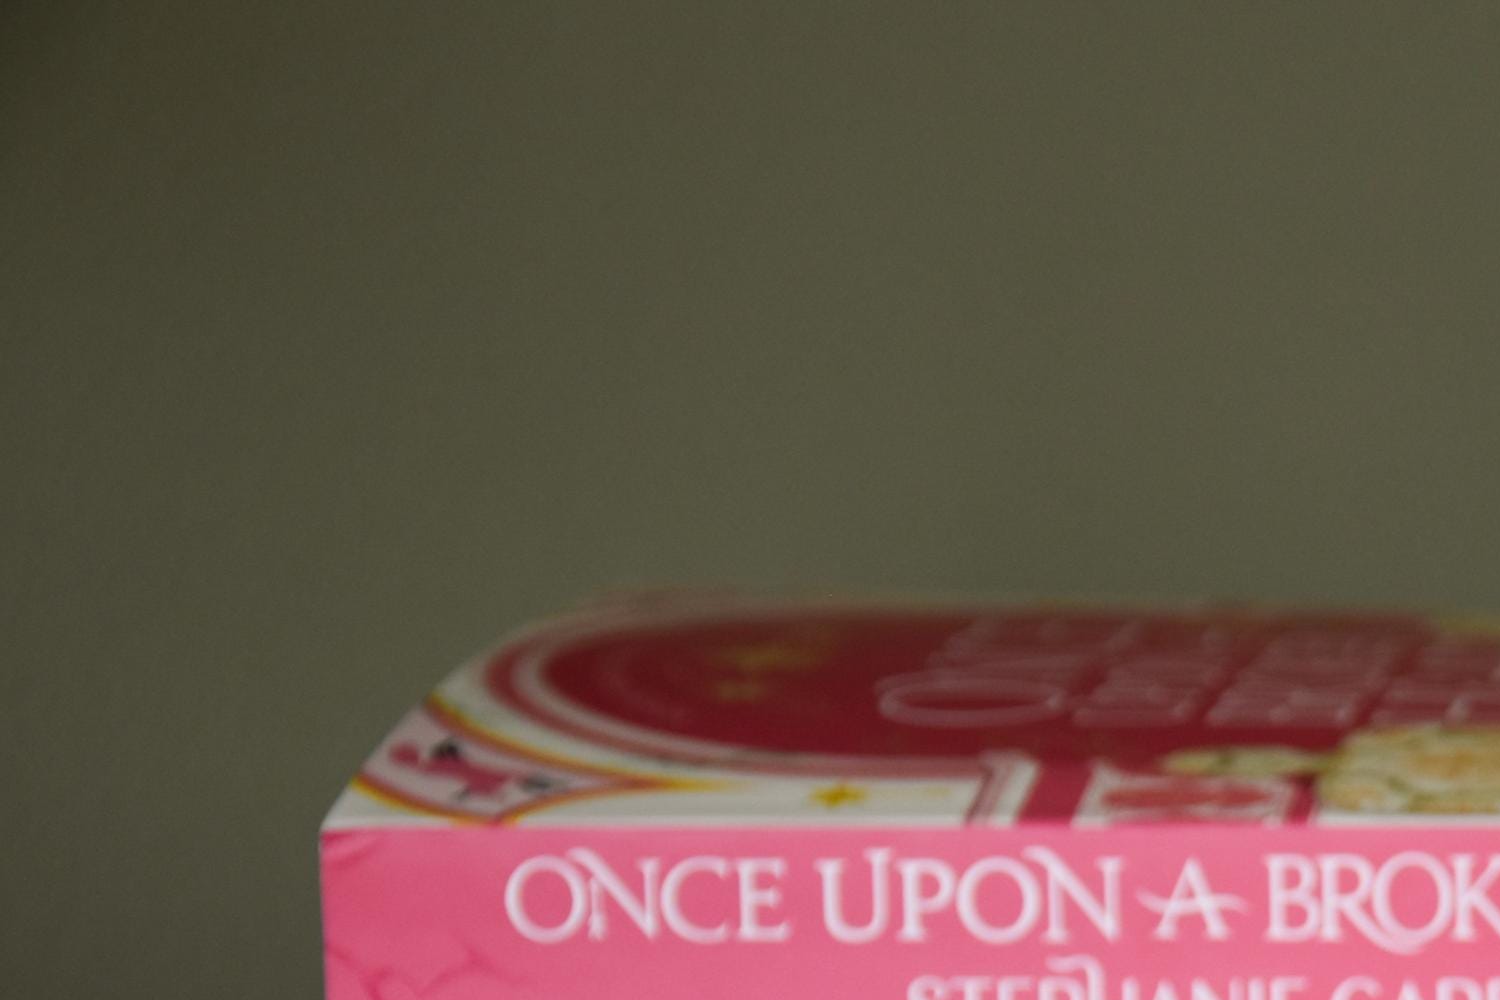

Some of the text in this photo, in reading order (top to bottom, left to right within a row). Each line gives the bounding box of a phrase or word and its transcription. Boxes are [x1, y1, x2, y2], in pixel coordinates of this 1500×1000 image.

[504, 846, 792, 944] ONCE
[814, 846, 1125, 944] UPON
[1137, 856, 1250, 940] A
